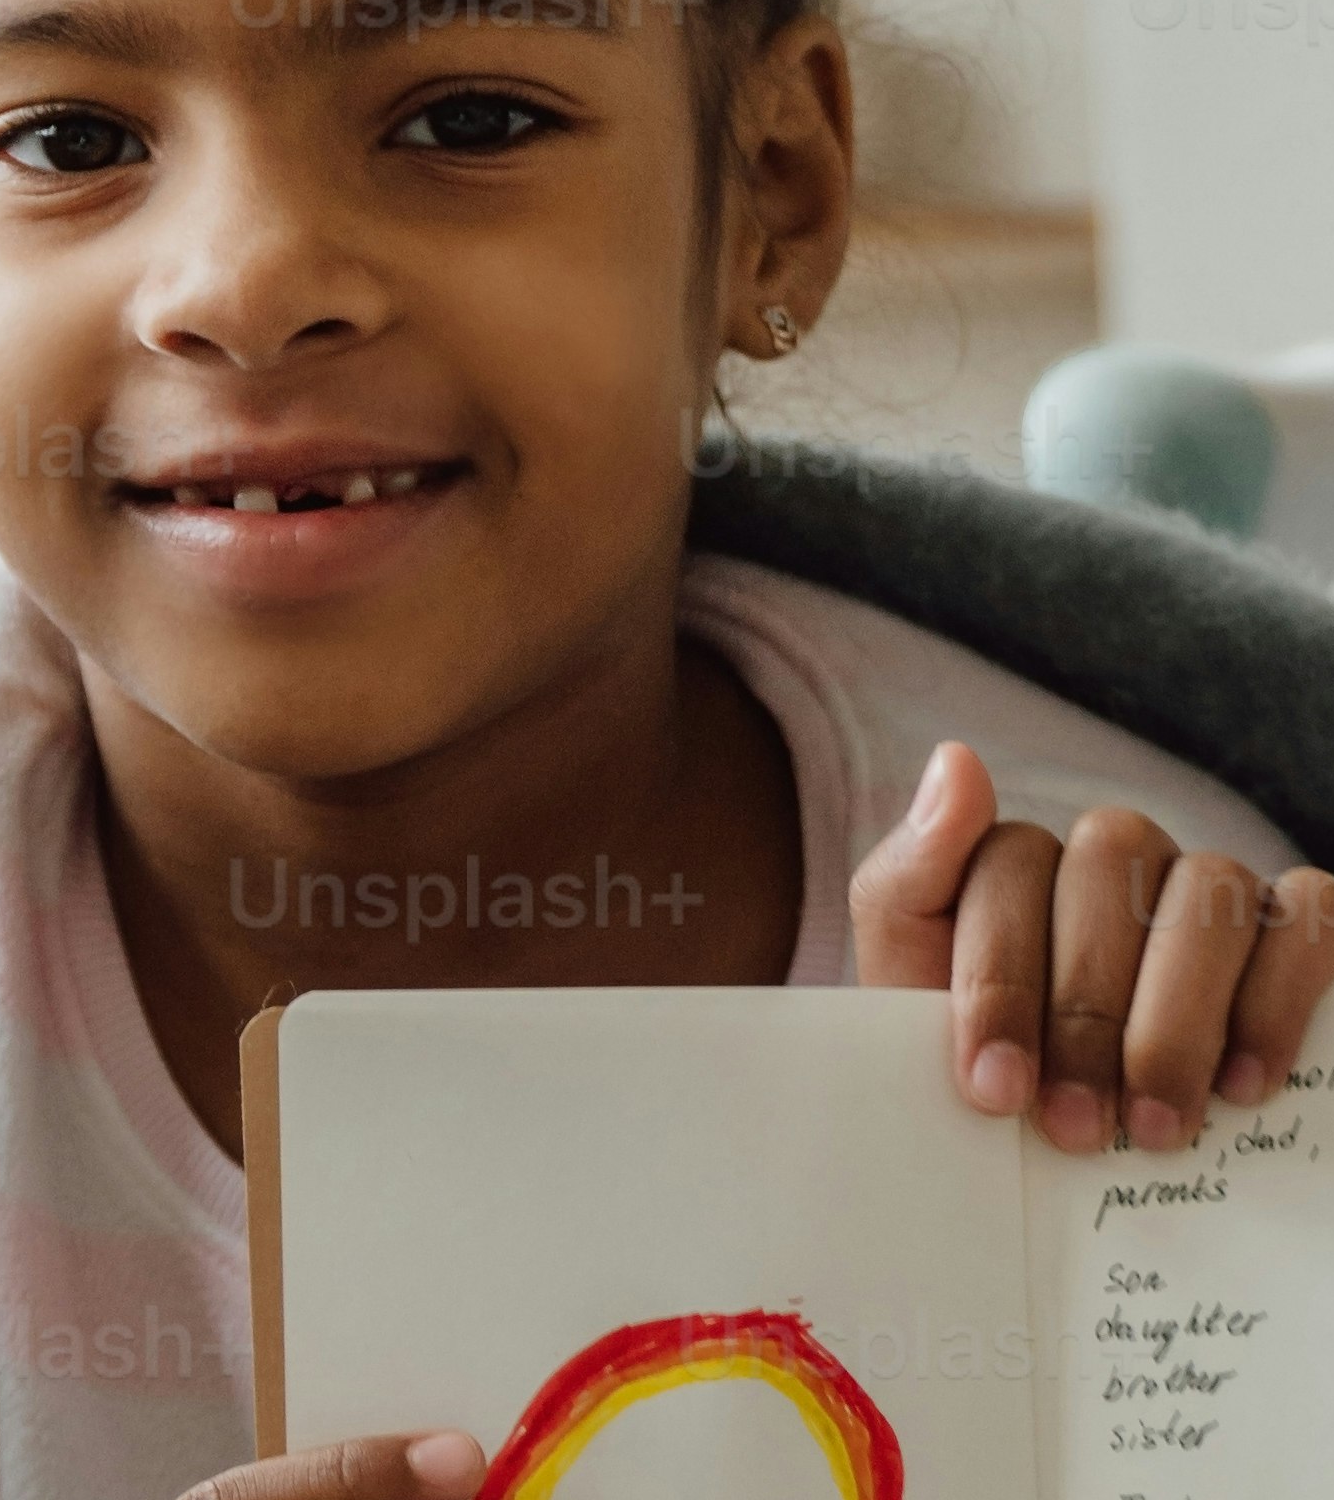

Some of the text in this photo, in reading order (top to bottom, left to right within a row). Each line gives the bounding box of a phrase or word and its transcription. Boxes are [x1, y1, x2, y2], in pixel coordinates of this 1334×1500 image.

[1094, 1172, 1229, 1232] parents
[1094, 1299, 1268, 1364] daughter
[1102, 1360, 1239, 1404] brother
[1109, 1409, 1220, 1453] sister
